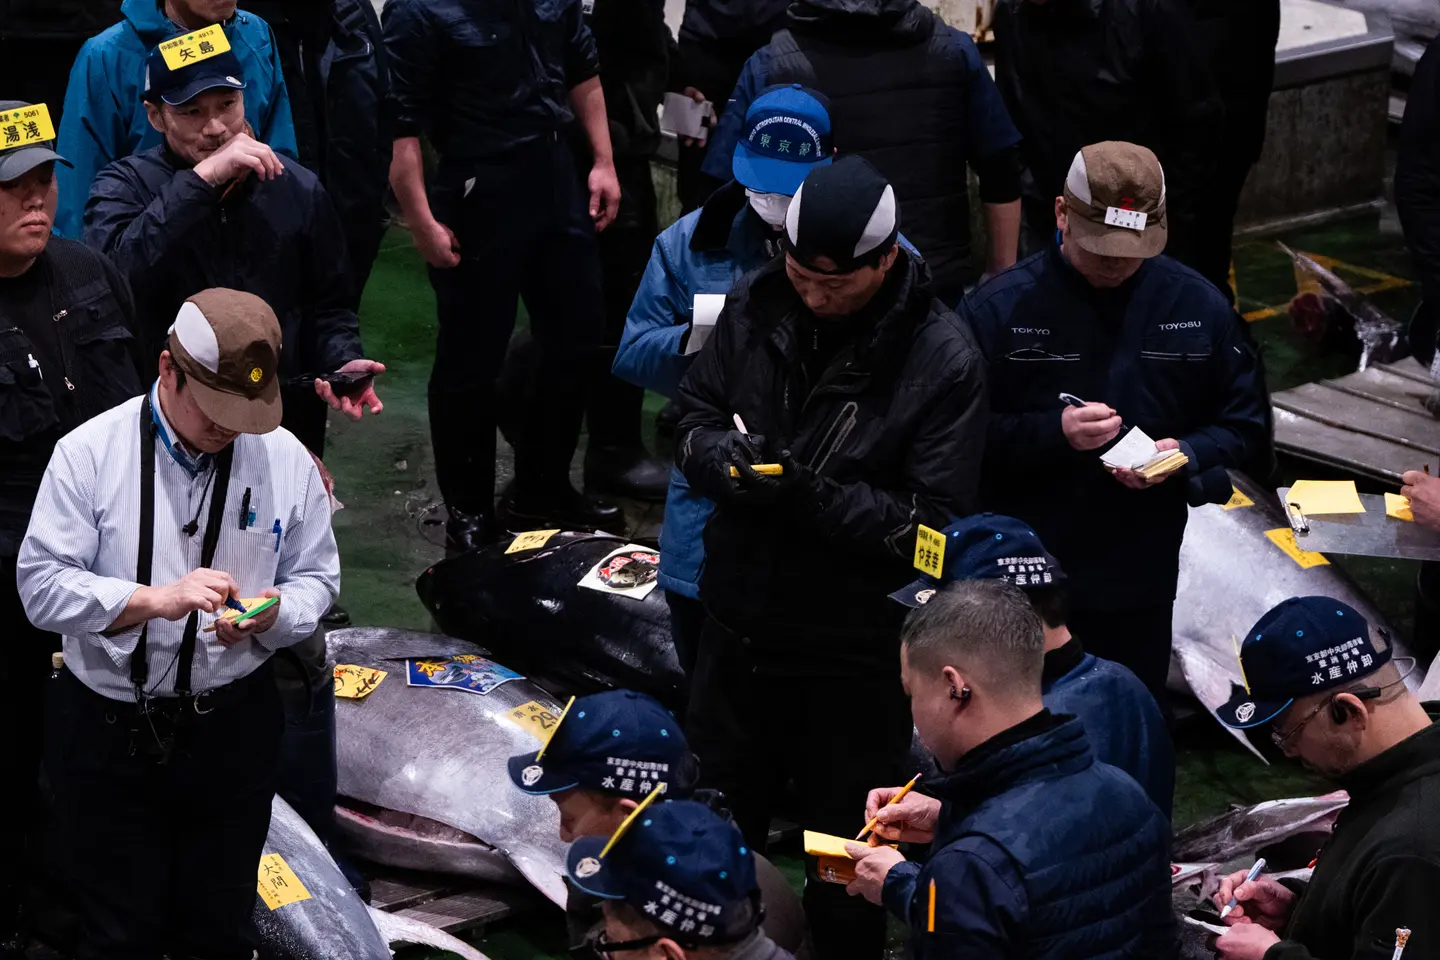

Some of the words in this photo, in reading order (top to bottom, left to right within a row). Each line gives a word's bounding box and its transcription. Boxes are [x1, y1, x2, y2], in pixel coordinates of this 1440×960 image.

[179, 41, 215, 62] 矢島
[784, 116, 803, 127] CENTRAL
[3, 120, 40, 144] 湯浅
[759, 133, 812, 157] 東京都
[1011, 327, 1051, 336] TOKYO
[1158, 320, 1202, 331] TOYOSU
[1311, 653, 1373, 685] 水産仲卸
[530, 711, 558, 730] 29
[601, 775, 668, 794] 水産仲卸
[263, 864, 288, 889] 大間
